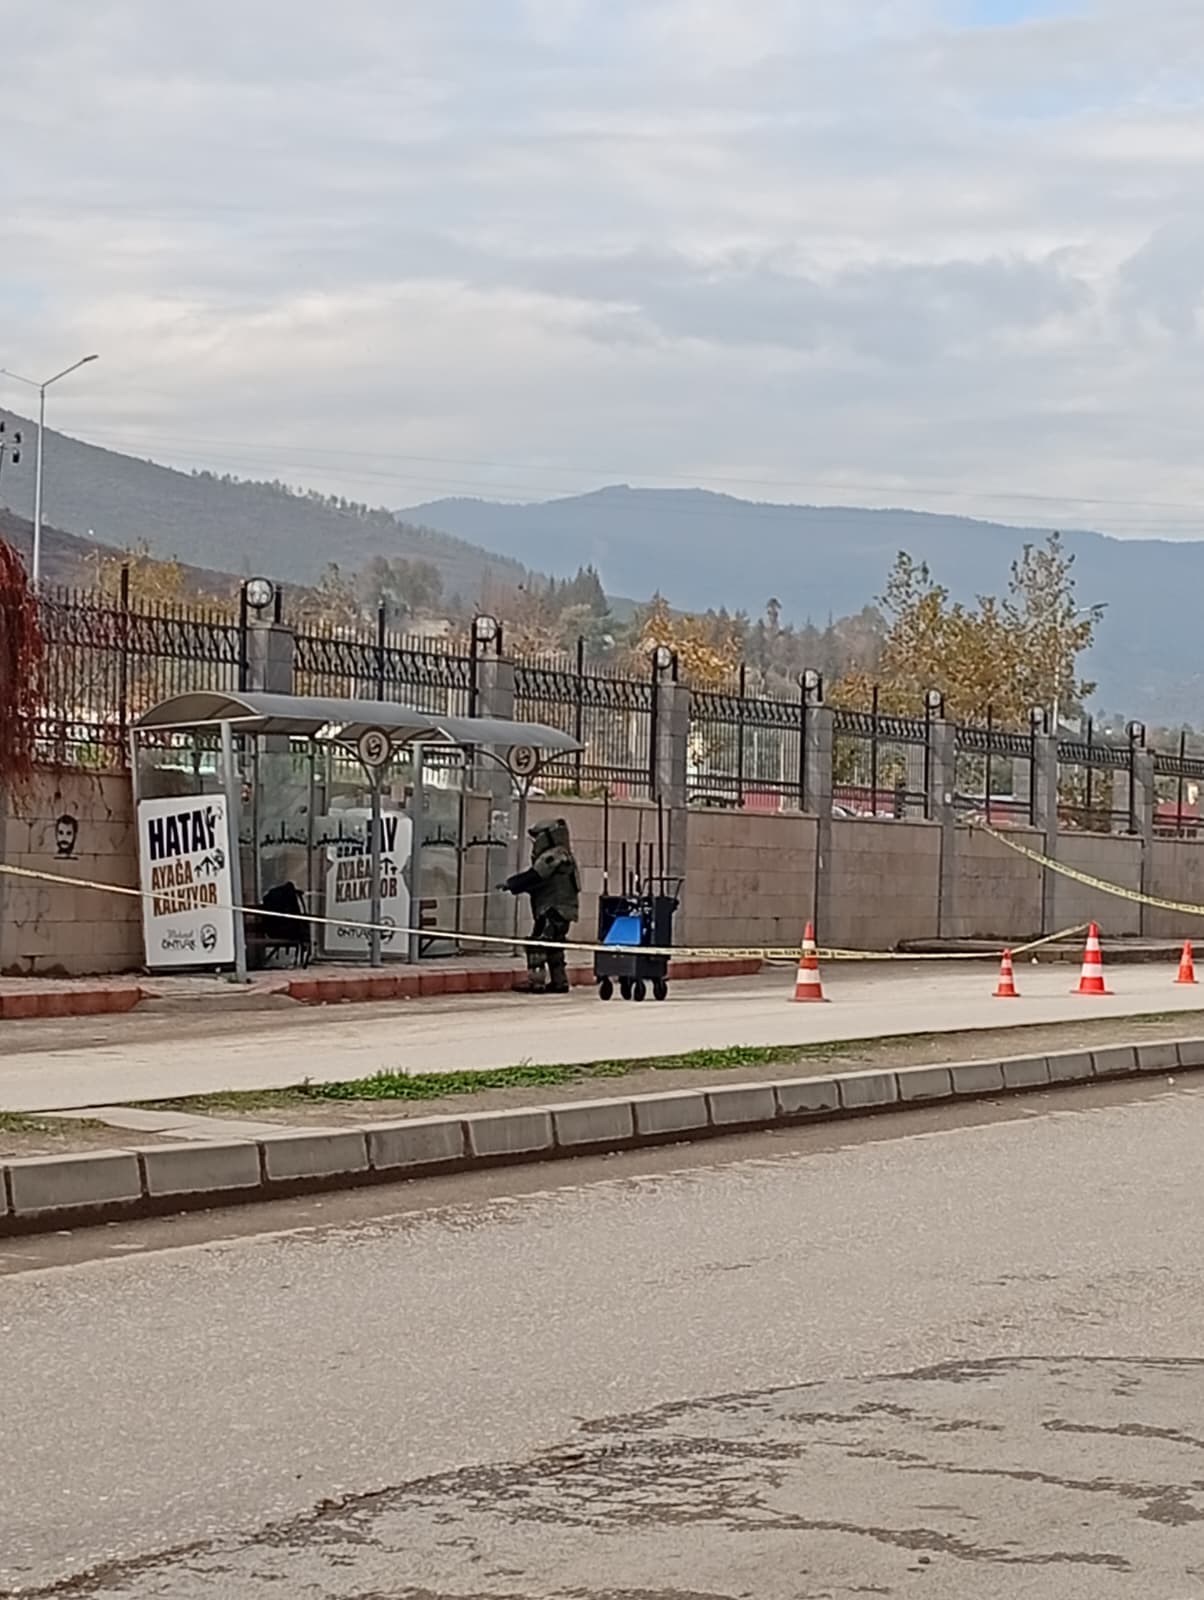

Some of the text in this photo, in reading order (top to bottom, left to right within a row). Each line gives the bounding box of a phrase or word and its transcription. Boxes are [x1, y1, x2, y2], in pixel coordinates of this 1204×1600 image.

[148, 806, 216, 861] HATAY
[151, 858, 193, 891] AYAĞA
[335, 876, 398, 904] KALKIOR
[152, 882, 218, 917] KALKIYOR
